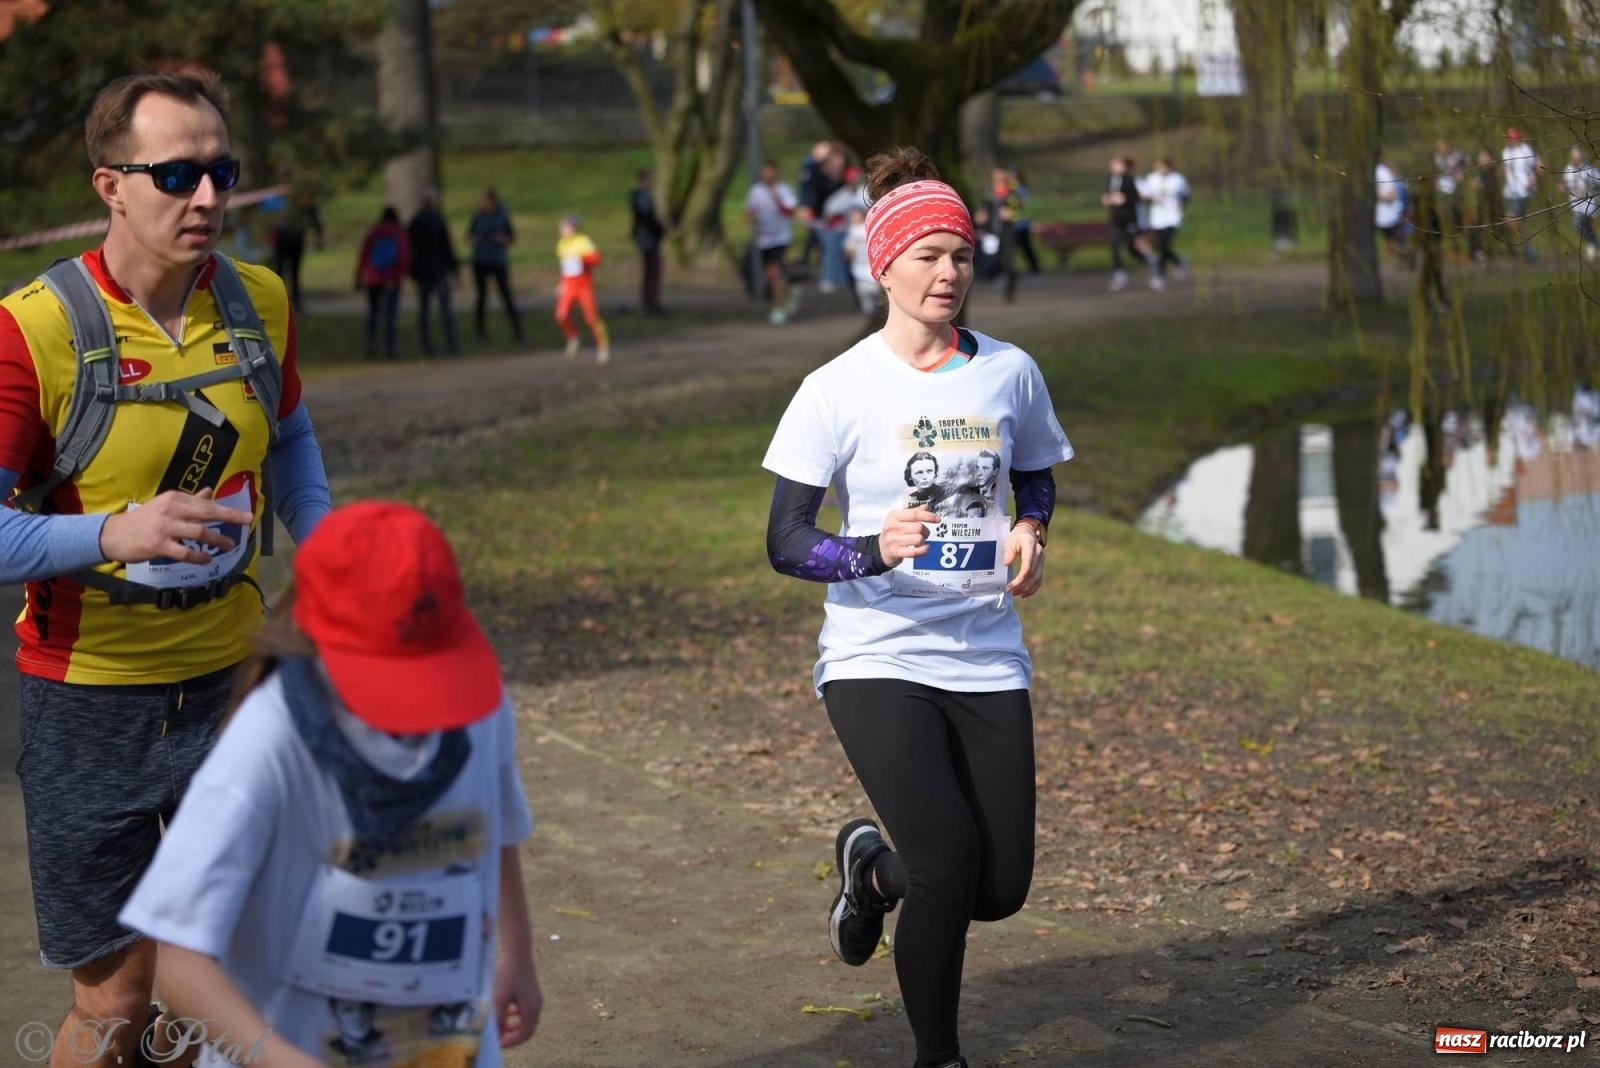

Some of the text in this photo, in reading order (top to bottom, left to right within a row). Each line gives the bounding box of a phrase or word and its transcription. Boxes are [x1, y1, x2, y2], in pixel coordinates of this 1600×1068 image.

[939, 418, 966, 427] TROPEM
[941, 427, 990, 440] WILCZYM
[951, 528, 981, 537] WILCZYM
[940, 543, 975, 569] 87
[371, 922, 430, 961] 91
